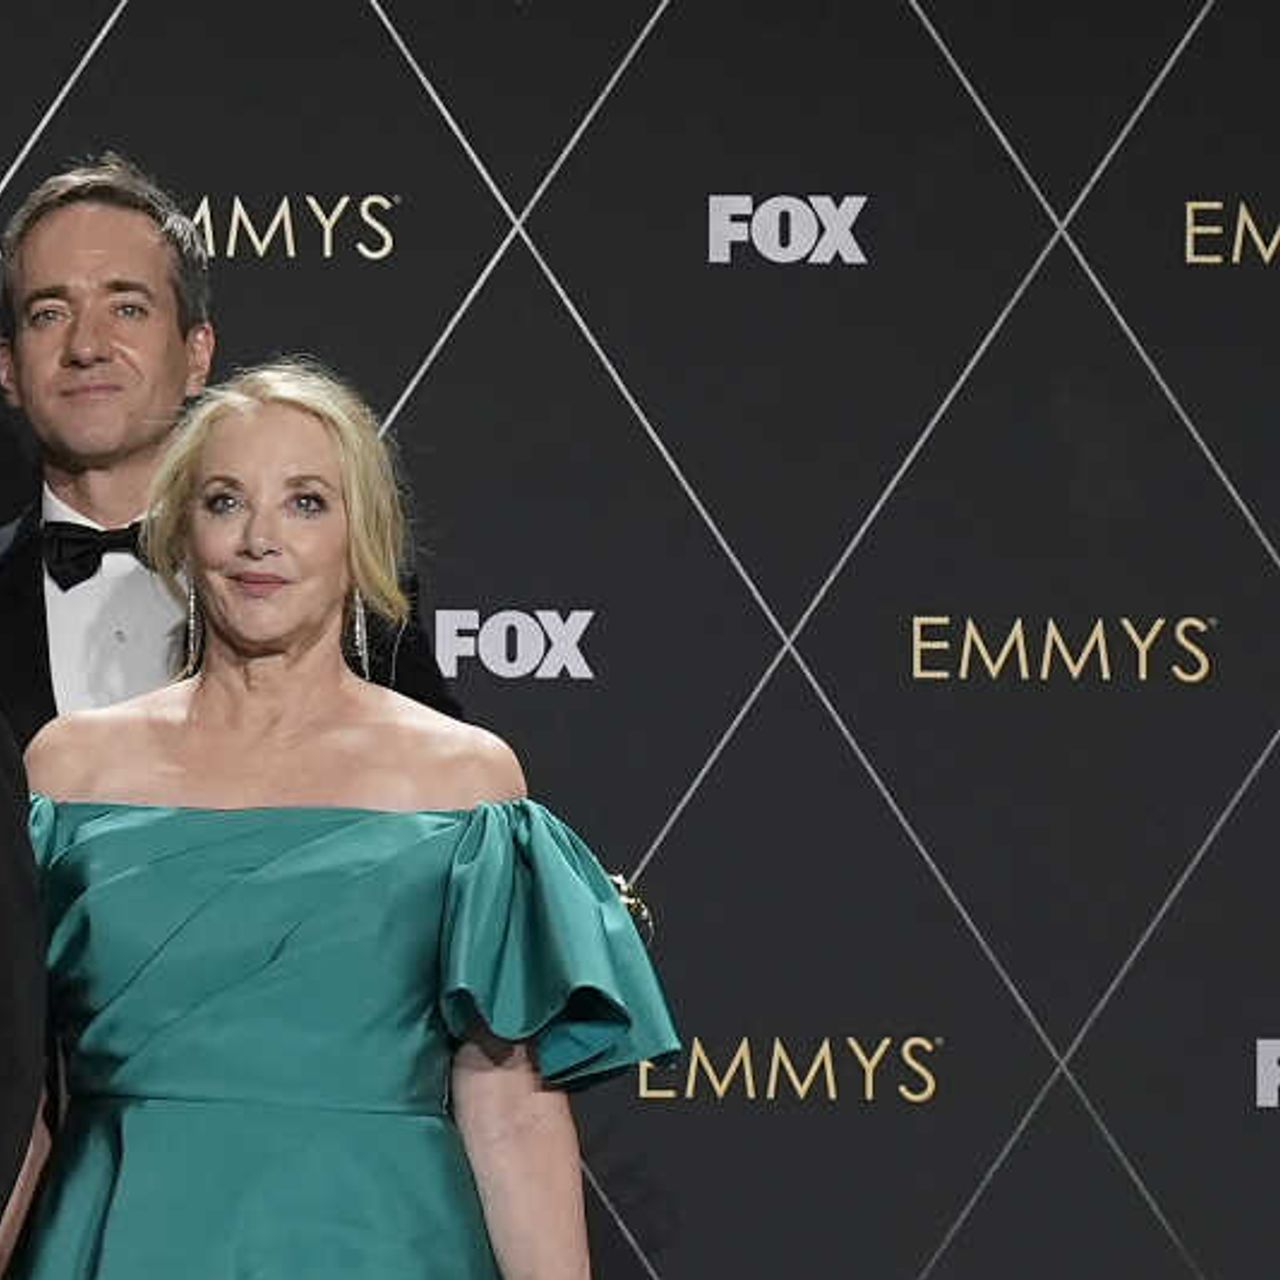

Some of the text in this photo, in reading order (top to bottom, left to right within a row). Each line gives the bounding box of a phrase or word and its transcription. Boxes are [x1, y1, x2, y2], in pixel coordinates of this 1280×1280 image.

[709, 195, 868, 264] FOX
[435, 610, 594, 679] FOX
[912, 616, 1210, 682] EMMYS
